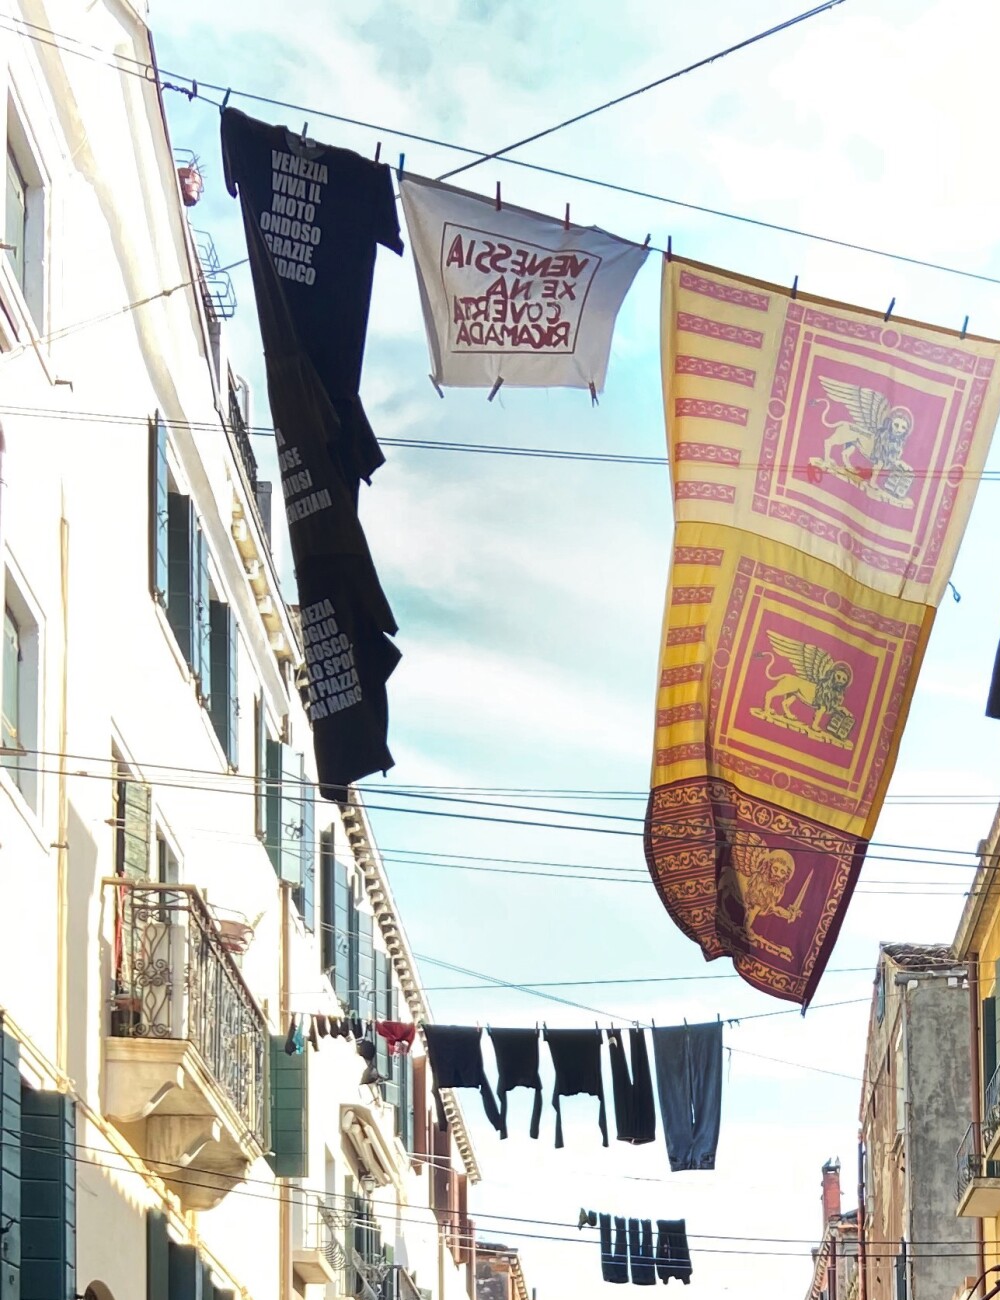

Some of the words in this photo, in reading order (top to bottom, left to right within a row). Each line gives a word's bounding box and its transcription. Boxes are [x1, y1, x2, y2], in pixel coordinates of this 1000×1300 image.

[271, 149, 328, 184] VENEZIA
[272, 171, 305, 199] VIVA
[308, 182, 321, 204] IL
[272, 193, 315, 222] MOTO
[260, 211, 321, 246] ONDOSO
[274, 257, 316, 286] DACO
[301, 598, 336, 627] NEZIA
[303, 617, 339, 647] OGLIO
[310, 700, 329, 720] AN
